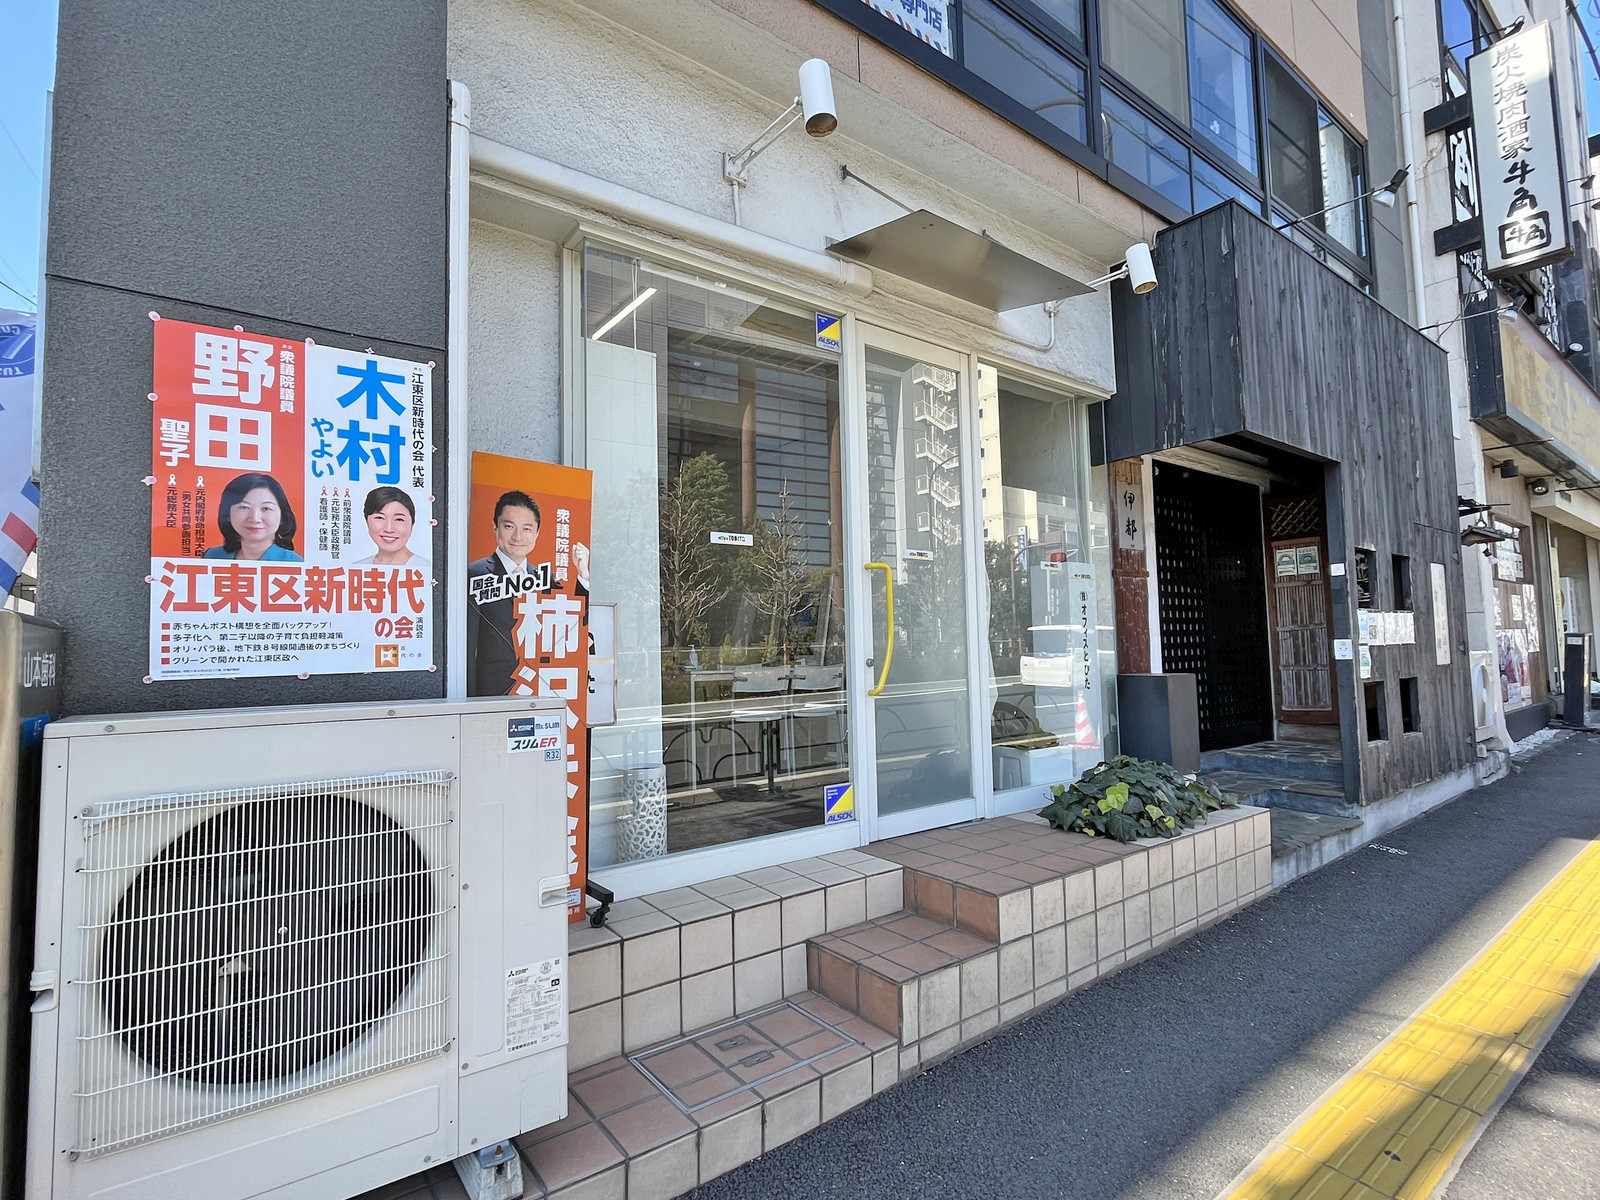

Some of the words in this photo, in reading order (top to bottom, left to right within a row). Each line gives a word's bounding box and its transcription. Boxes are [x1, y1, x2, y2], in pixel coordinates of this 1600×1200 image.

[818, 337, 840, 348] ALSOK
[279, 350, 295, 414] 衆議院議員
[192, 332, 275, 472] 野田
[411, 372, 425, 462] 江東区新時代の会
[336, 359, 406, 485] 木村
[159, 417, 190, 467] 聖子
[310, 417, 334, 479] やよい
[412, 465, 425, 489] 代表
[166, 486, 178, 528] 元総務大臣
[342, 500, 352, 544] 前衆議院議員
[1123, 490, 1137, 541] 伊都
[331, 498, 341, 560] 元総務大臣政務官
[555, 508, 570, 582] 衆議院議員
[160, 561, 425, 613] 江東区新時代
[472, 576, 495, 592] 国会
[479, 587, 501, 602] 質問
[505, 564, 549, 596] No.1
[172, 633, 212, 642] 多子化へ
[374, 616, 414, 639] の会
[415, 617, 424, 638] 演説会
[23, 651, 57, 688] 山本歯科
[511, 738, 557, 750] スリムER
[546, 751, 560, 759] R32
[826, 811, 854, 823] ALSOK
